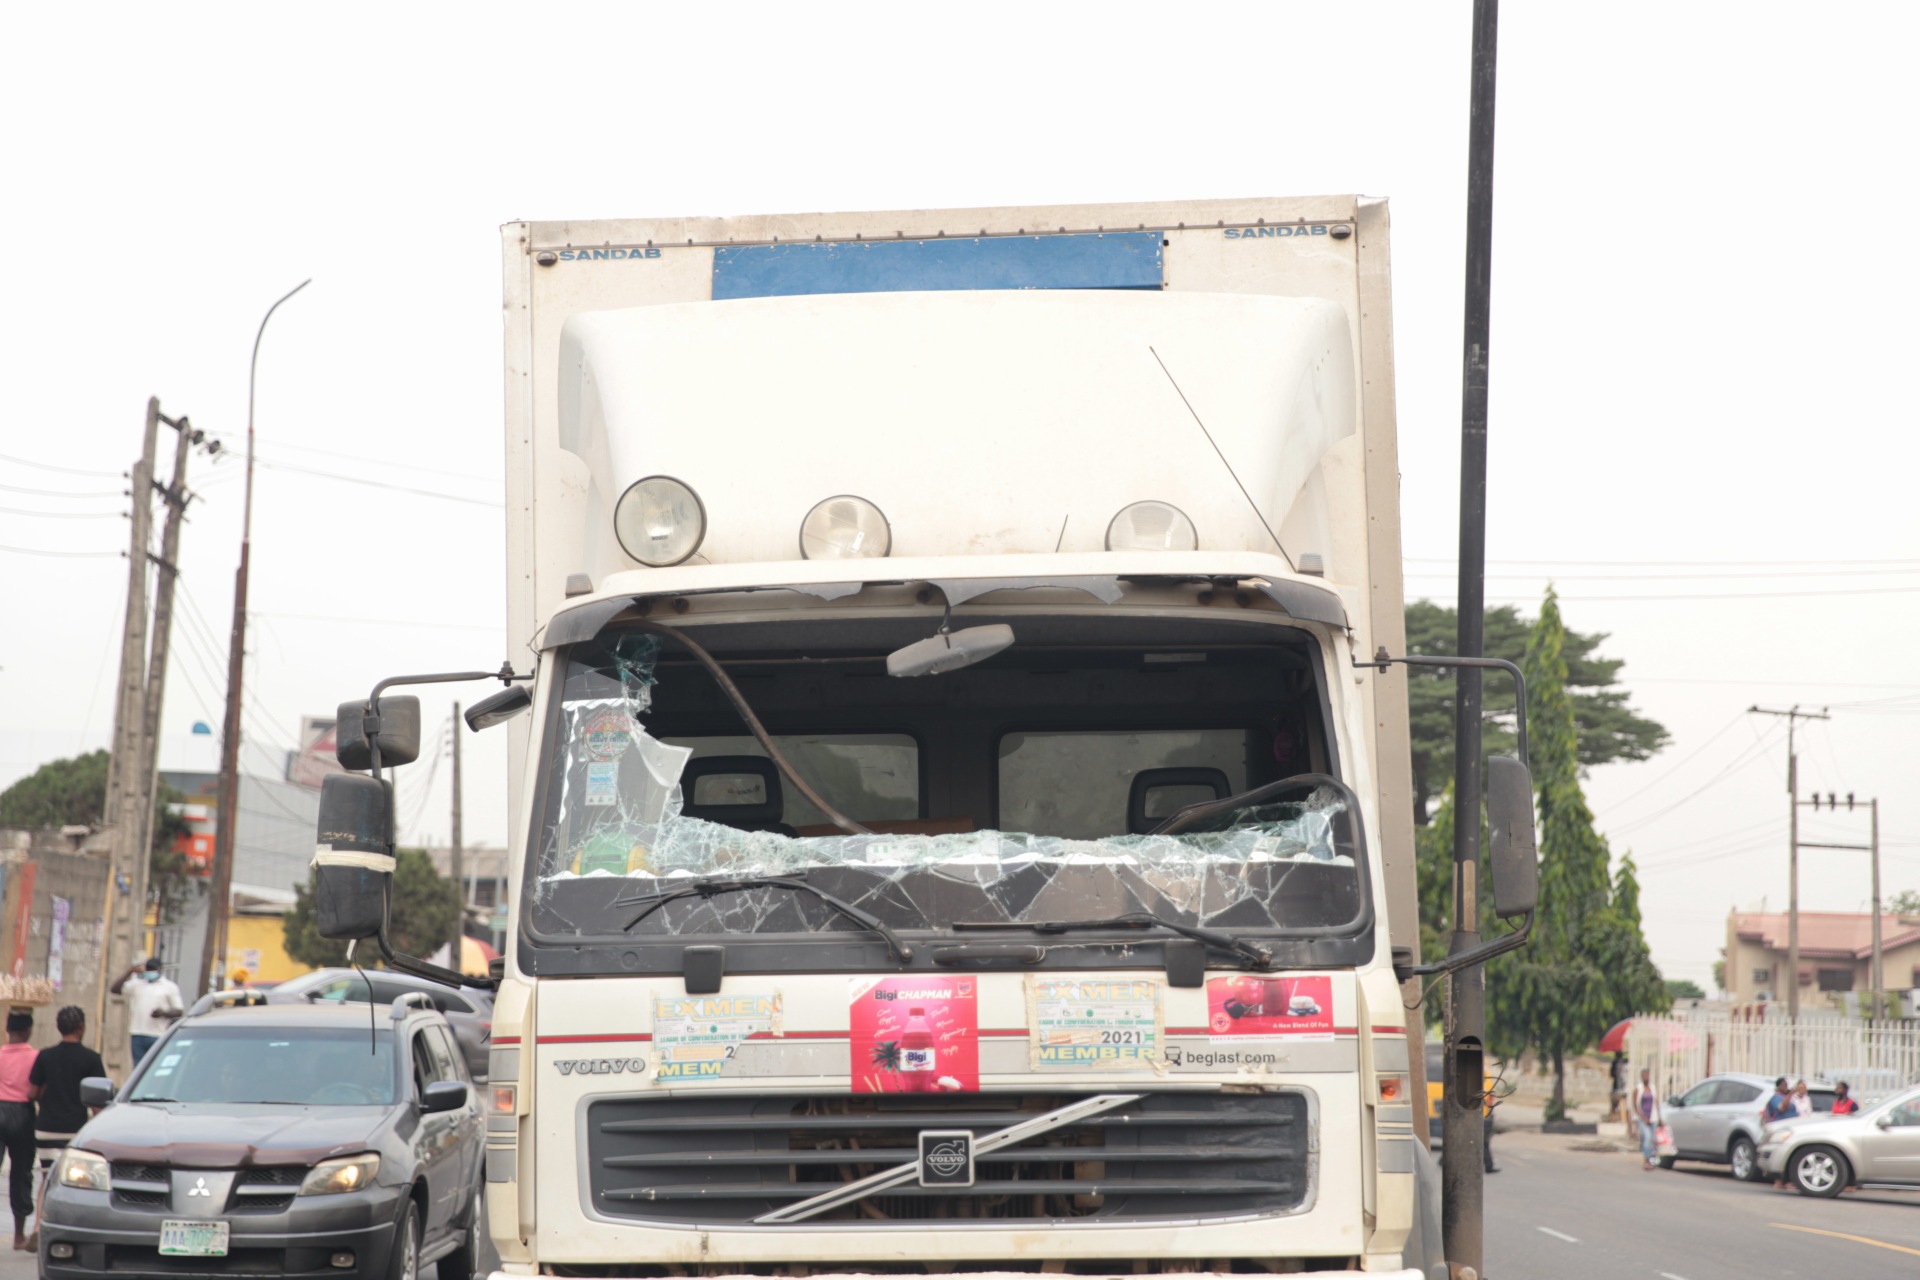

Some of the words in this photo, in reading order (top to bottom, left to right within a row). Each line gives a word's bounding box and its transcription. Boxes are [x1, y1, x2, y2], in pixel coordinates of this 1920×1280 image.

[1224, 225, 1328, 239] SANDAB
[559, 248, 662, 261] SANDAB
[875, 990, 897, 1001] Bigi
[898, 989, 952, 1000] CHAPMAN
[1101, 1031, 1141, 1044] 2021
[907, 1052, 927, 1062] Bigi
[1039, 1046, 1155, 1060] MEMBER
[553, 1058, 646, 1075] VOLVO
